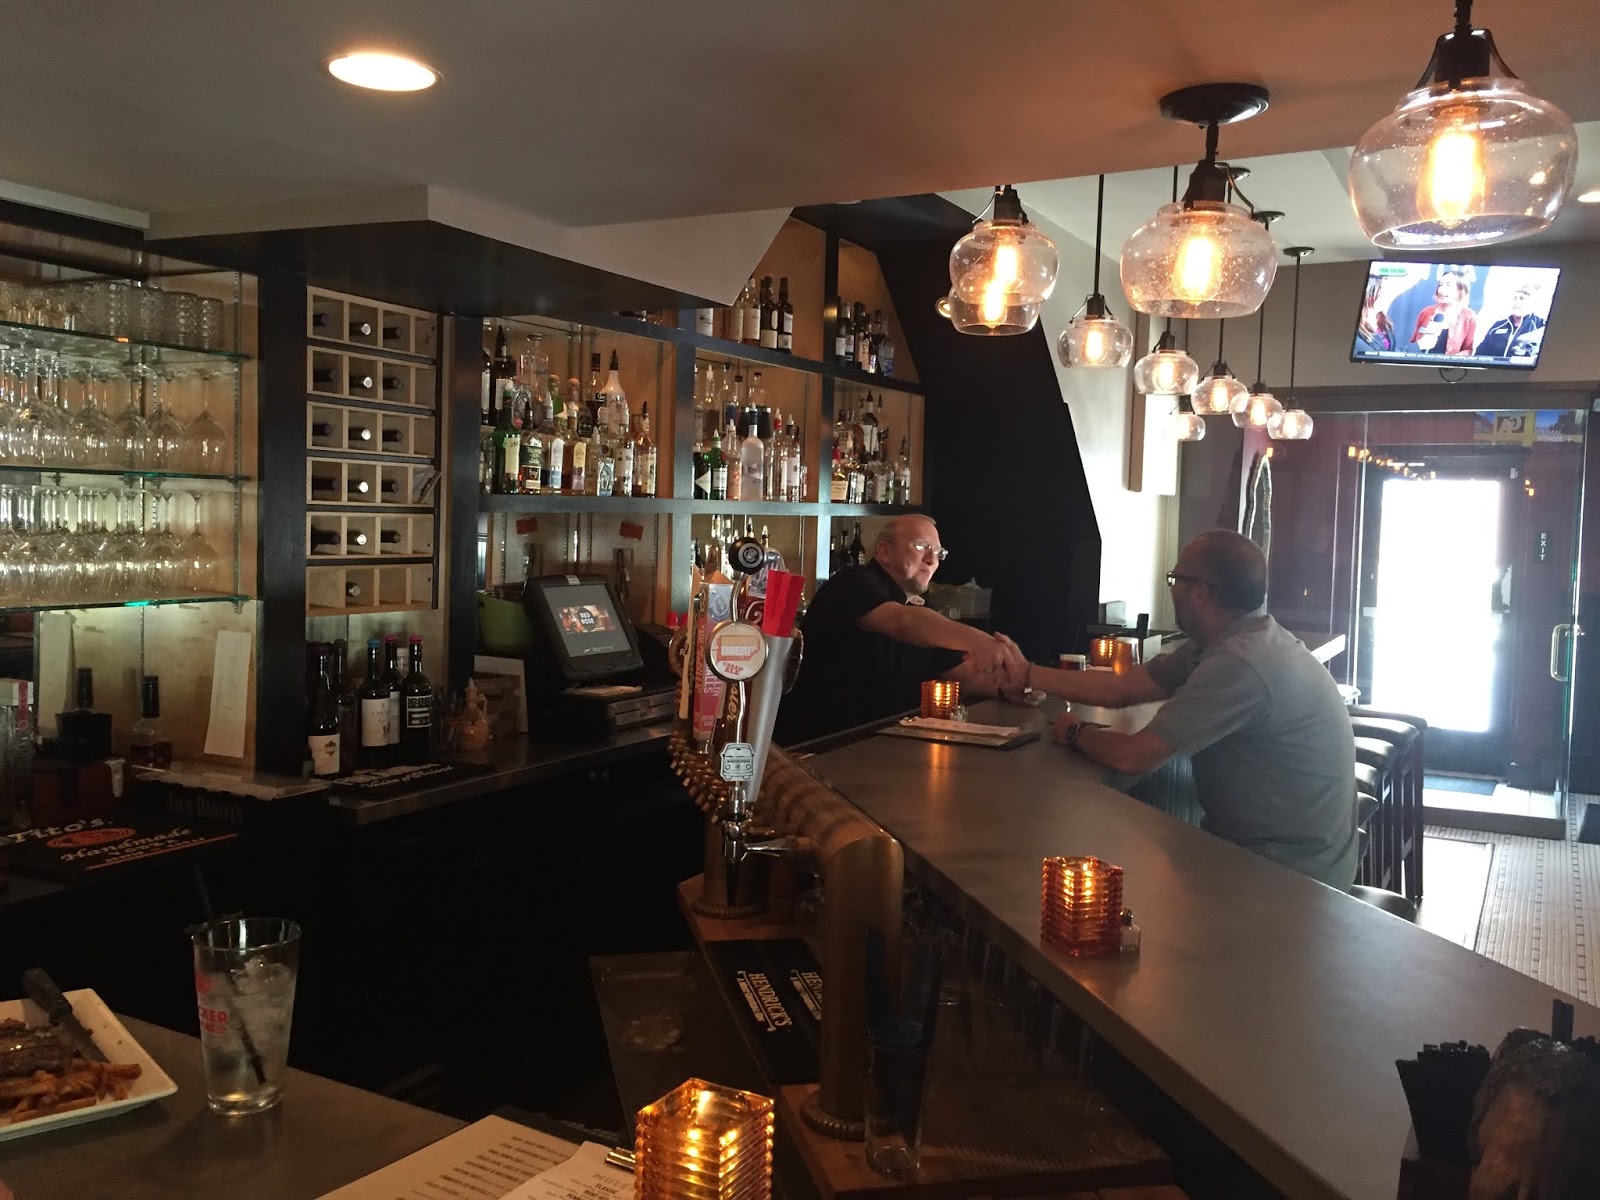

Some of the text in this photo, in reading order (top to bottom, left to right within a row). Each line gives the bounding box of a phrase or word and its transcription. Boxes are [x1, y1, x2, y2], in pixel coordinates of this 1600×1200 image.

[1540, 532, 1548, 561] EXIT
[579, 611, 591, 619] RED
[7, 817, 106, 844] Tito's
[60, 827, 193, 862] Handmade
[748, 973, 793, 1027] HENDRICK'S
[594, 1183, 619, 1195] CLASSIC
